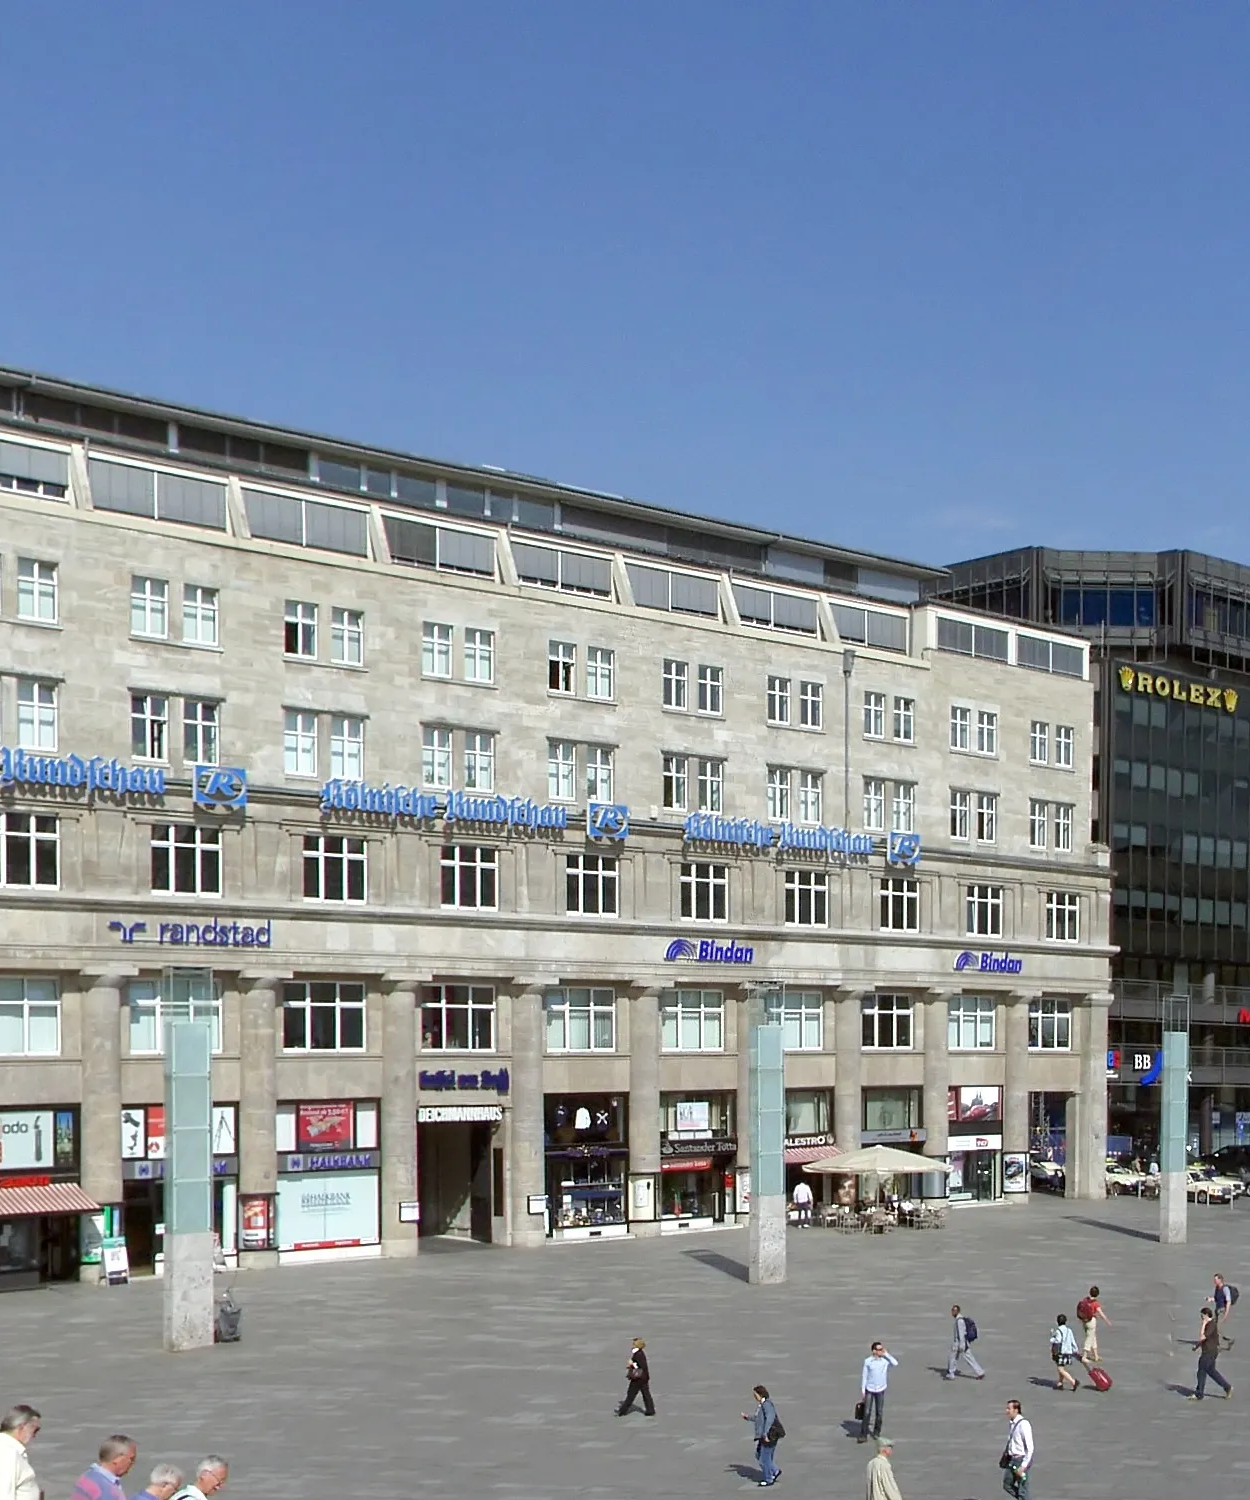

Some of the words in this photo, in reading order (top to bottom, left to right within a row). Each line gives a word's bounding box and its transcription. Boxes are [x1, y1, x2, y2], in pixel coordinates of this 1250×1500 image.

[1138, 672, 1221, 707] ROLEX
[2, 746, 166, 795] Rundschau
[320, 778, 437, 819] Kölnische
[443, 788, 567, 830] Rundschau
[159, 917, 271, 947] randstad
[699, 939, 753, 962] Bindan
[980, 952, 1022, 974] Bindan
[1134, 1054, 1151, 1070] BB
[418, 1107, 502, 1122] DEICHMANNHAUS
[674, 1142, 715, 1153] Santander
[716, 1142, 737, 1151] Totta
[784, 1135, 826, 1146] ALESTRO
